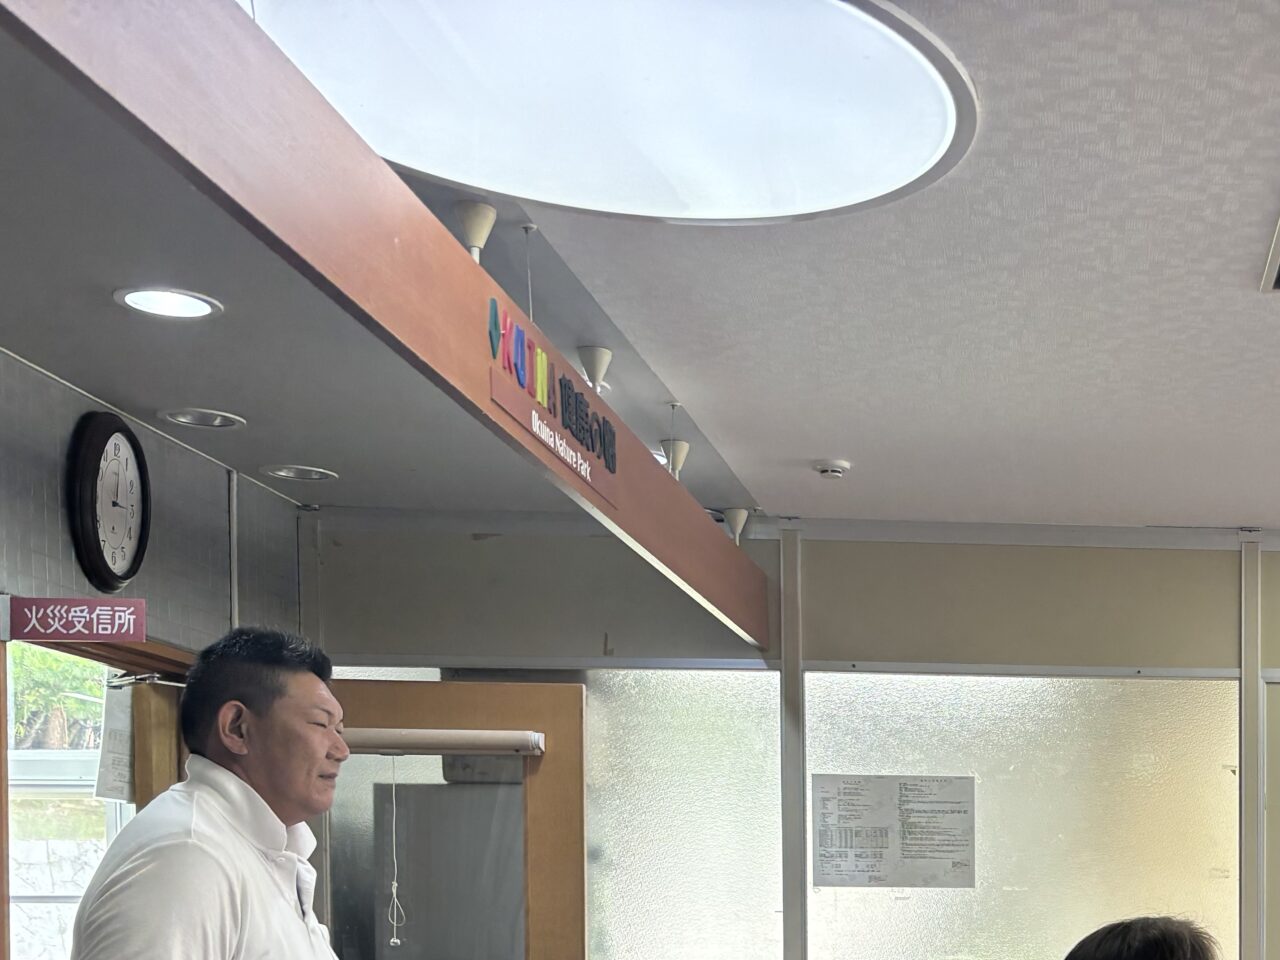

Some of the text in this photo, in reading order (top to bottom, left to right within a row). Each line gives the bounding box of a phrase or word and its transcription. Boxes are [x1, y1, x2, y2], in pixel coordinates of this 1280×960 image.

[531, 410, 592, 482] Okuina Nature Park
[23, 604, 137, 635] 火災受信所
